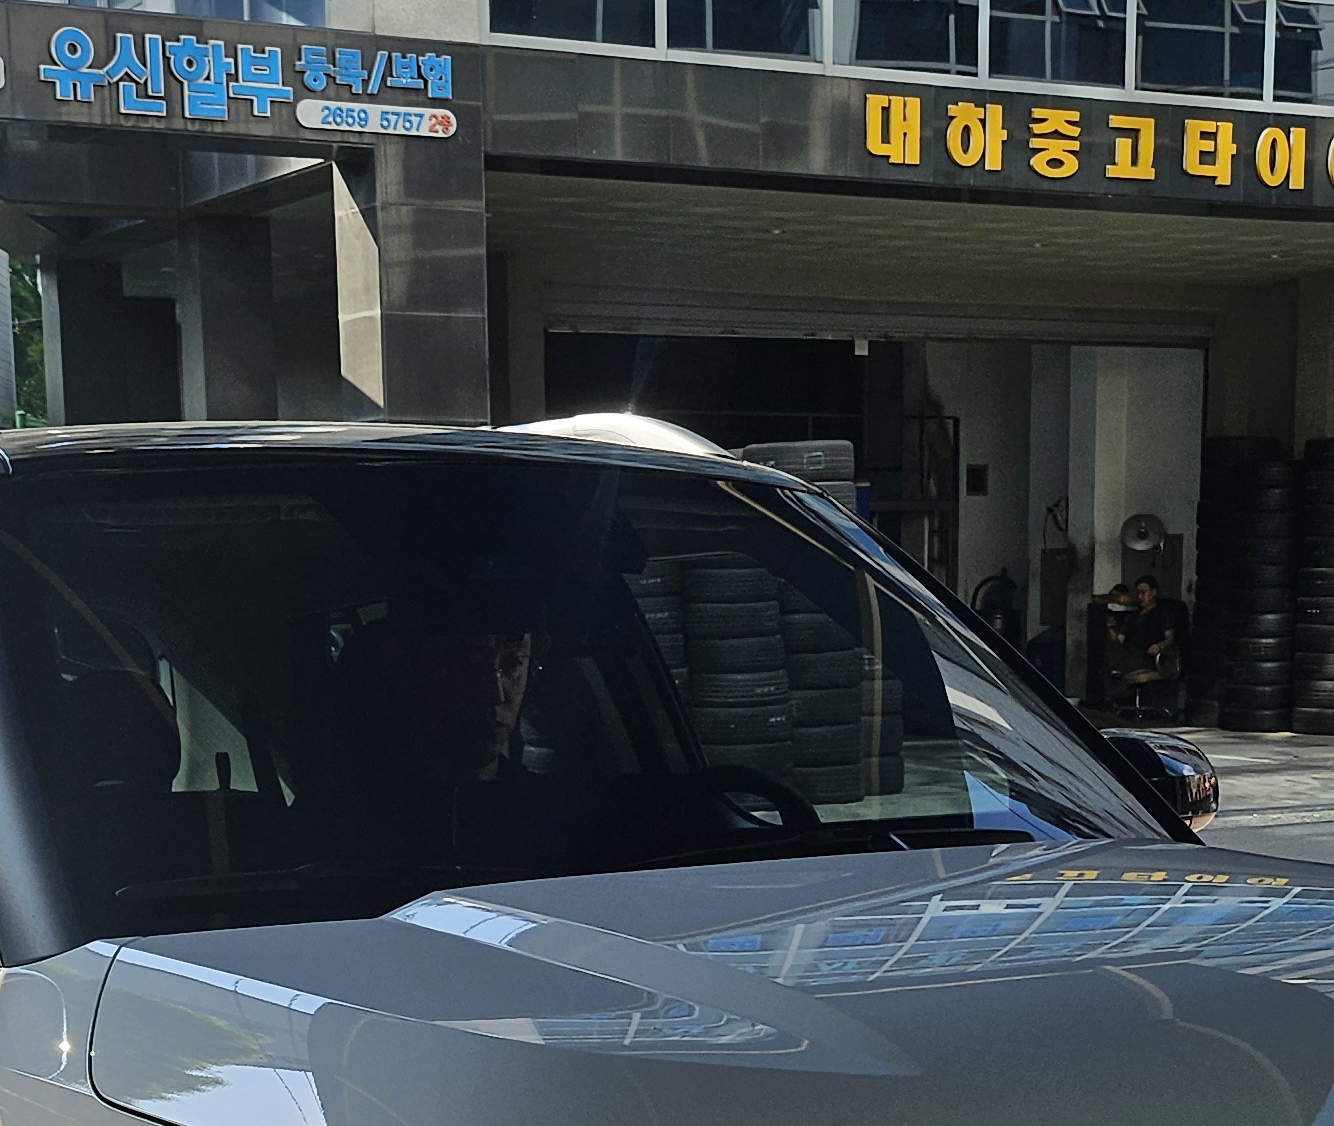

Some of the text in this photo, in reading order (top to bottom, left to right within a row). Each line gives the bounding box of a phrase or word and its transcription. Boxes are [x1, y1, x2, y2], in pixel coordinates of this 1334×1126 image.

[39, 26, 452, 120] 유신할부 등록/보험
[320, 105, 369, 128] 2659
[379, 110, 425, 132] 5757
